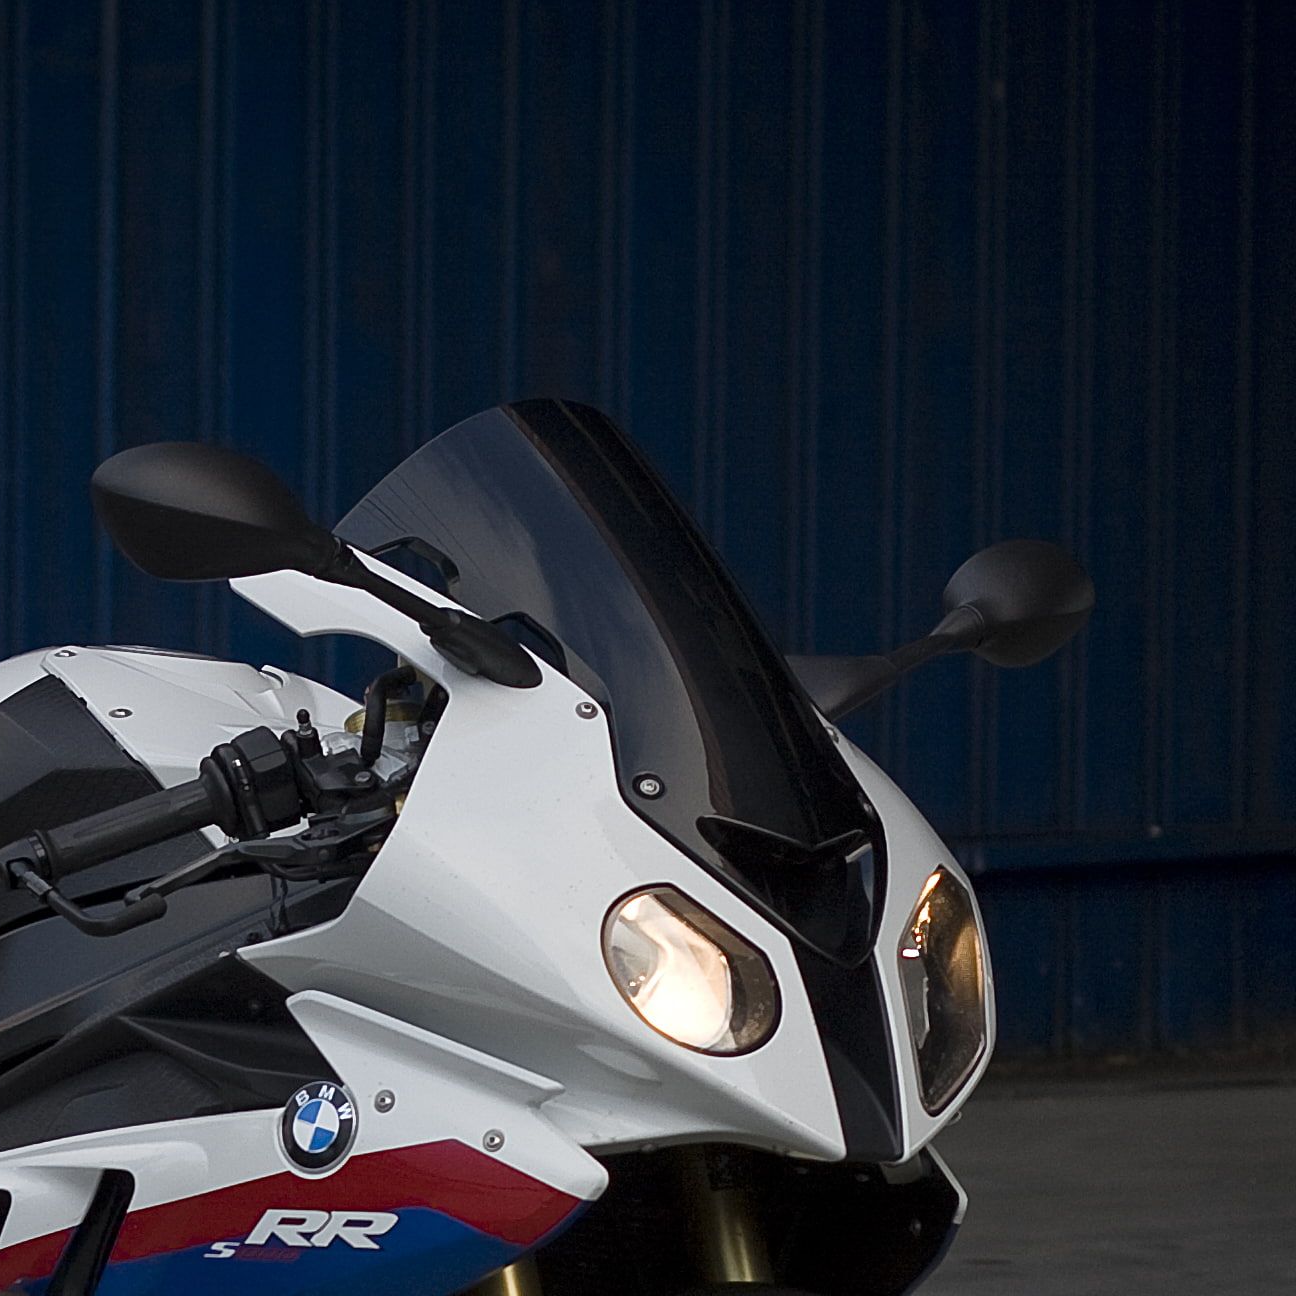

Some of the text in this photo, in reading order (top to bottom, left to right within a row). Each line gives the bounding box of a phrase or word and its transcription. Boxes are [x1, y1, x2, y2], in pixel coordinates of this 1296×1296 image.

[295, 1084, 353, 1120] BMW
[203, 1241, 241, 1259] S
[244, 1208, 400, 1250] RR
